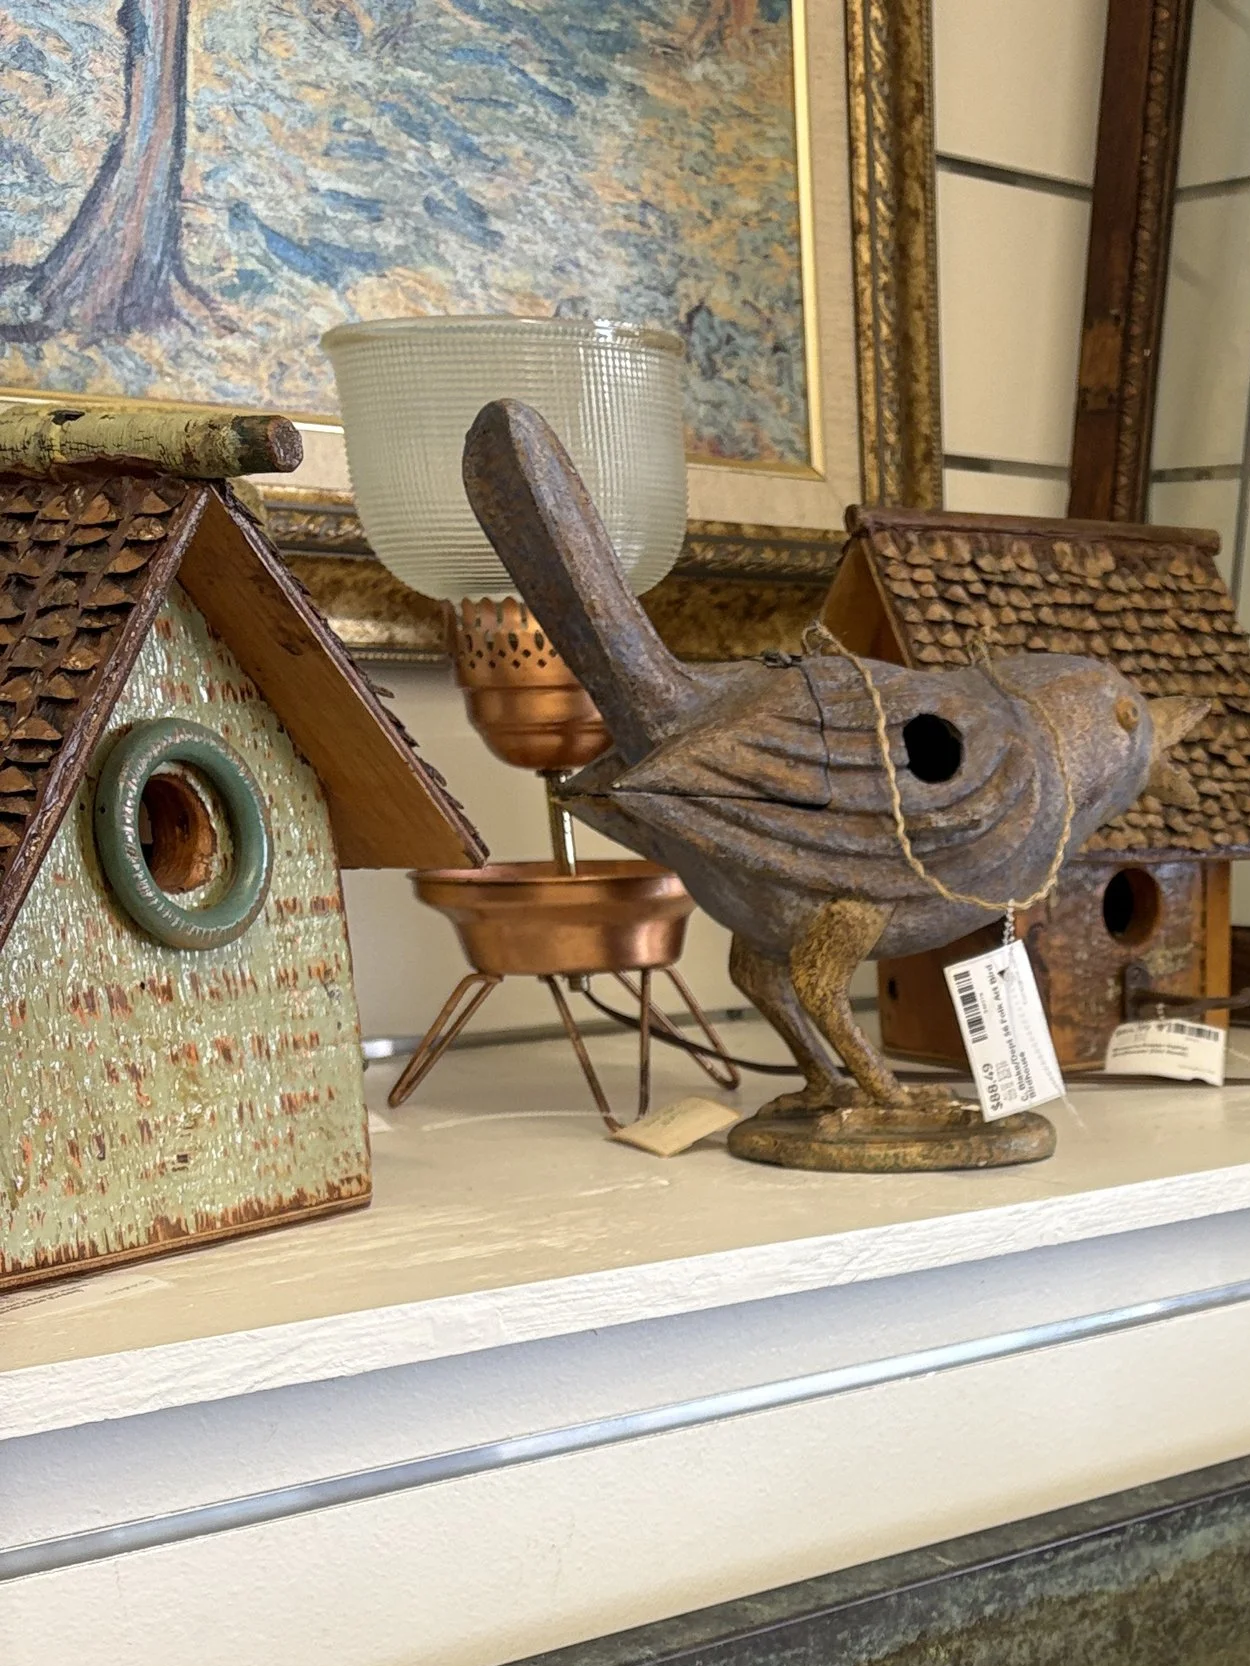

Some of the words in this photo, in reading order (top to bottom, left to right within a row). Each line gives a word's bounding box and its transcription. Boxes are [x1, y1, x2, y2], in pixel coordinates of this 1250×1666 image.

[984, 963, 996, 985] Bird
[991, 986, 1001, 1001] Art
[995, 1003, 1007, 1023] Folk
[1017, 1050, 1037, 1098] Birdhouse
[979, 1061, 1003, 1112] $88.49
